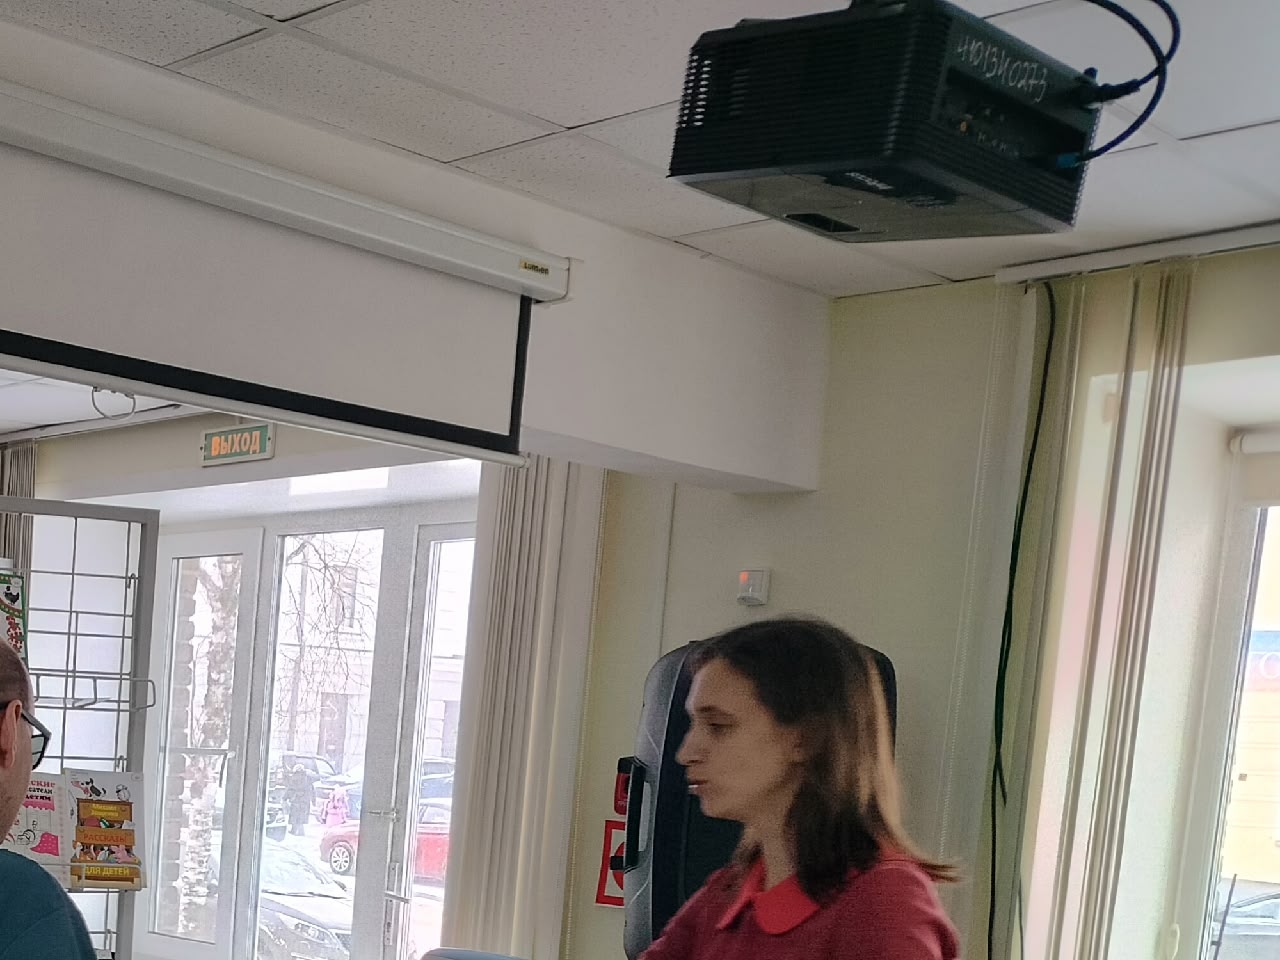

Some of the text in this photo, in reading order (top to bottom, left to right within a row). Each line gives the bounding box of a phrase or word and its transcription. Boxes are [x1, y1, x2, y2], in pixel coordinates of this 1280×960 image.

[211, 431, 261, 456] ВЫХОД
[83, 833, 126, 843] РАССКАЗЫ
[102, 867, 130, 877] ДЕТЕЙ
